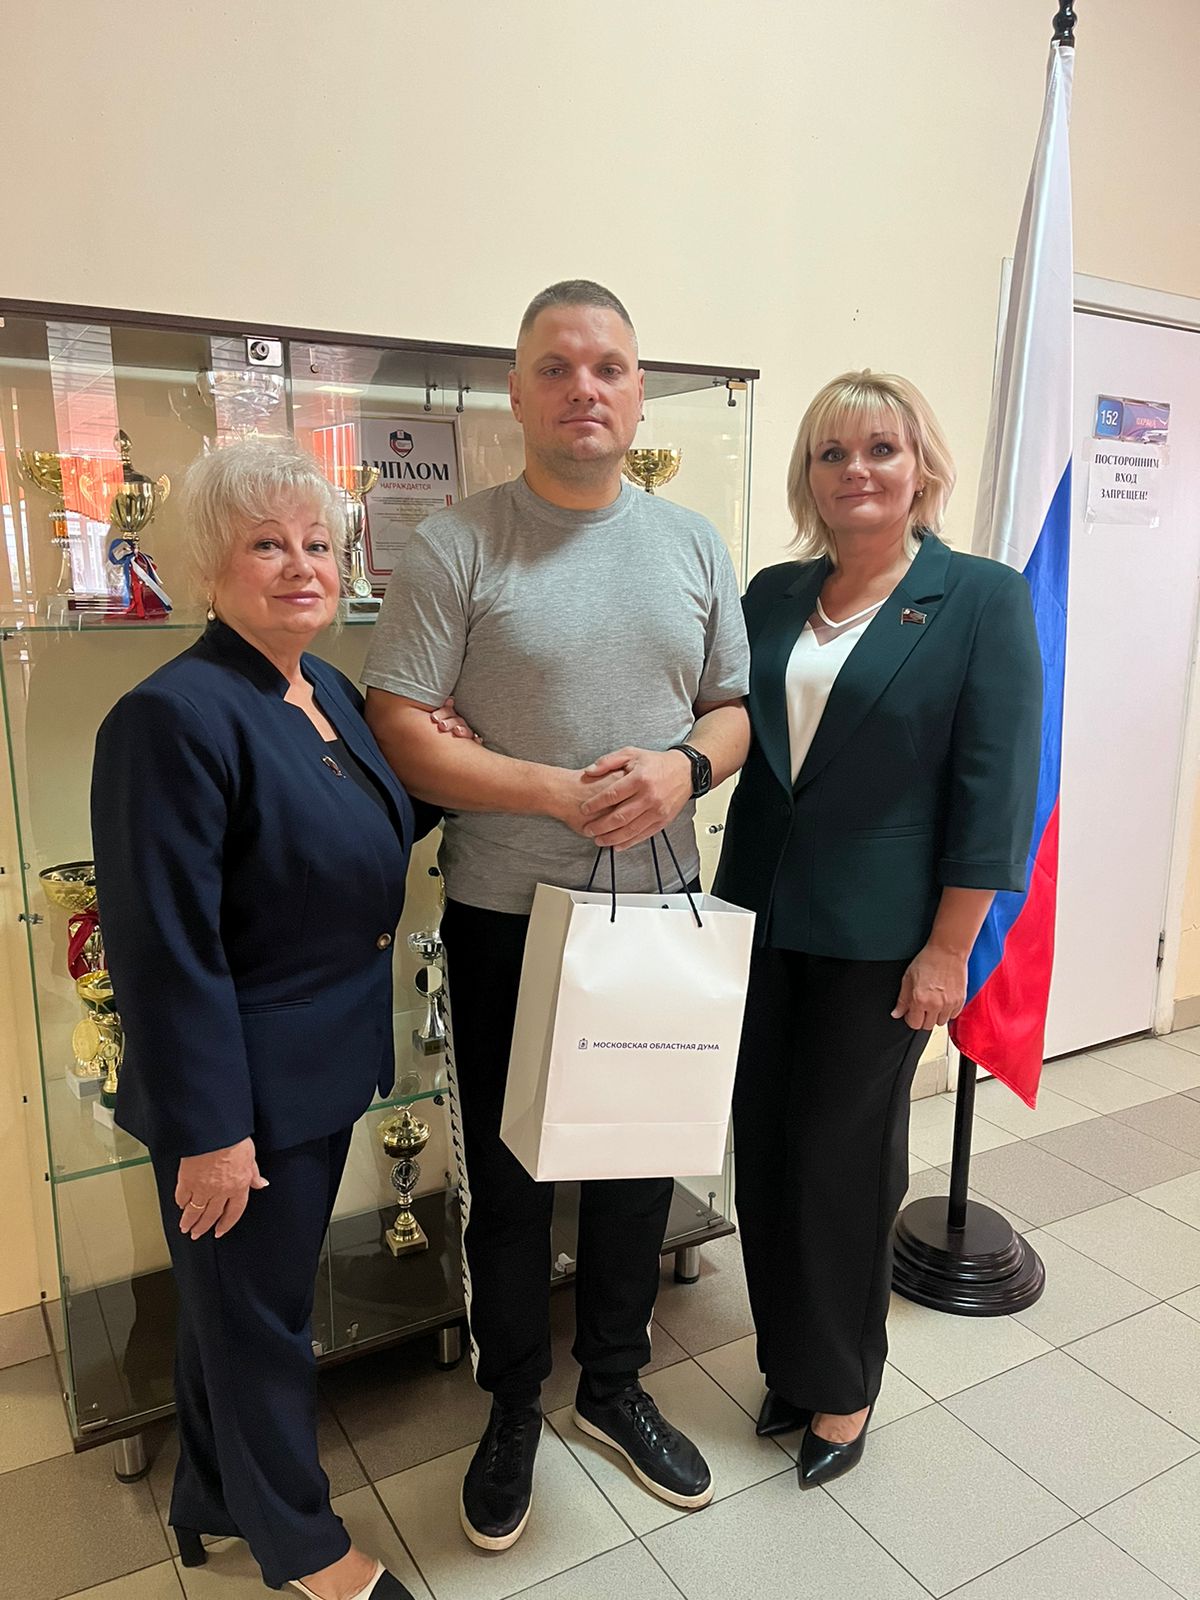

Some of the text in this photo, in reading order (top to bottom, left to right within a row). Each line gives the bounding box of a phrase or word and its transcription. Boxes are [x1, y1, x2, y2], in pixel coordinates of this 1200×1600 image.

[1101, 410, 1119, 426] 152
[1095, 454, 1160, 468] ПОСТОРОННИМ
[1115, 473, 1137, 484] ВХОД
[381, 482, 432, 491] НАГРАЖДАЕТСЯ
[1101, 488, 1148, 501] ЗАПРЕЩЕН!
[593, 1041, 720, 1051] МОСКОВСКАЯ ОБЛАСТНАЯ ДУМА
